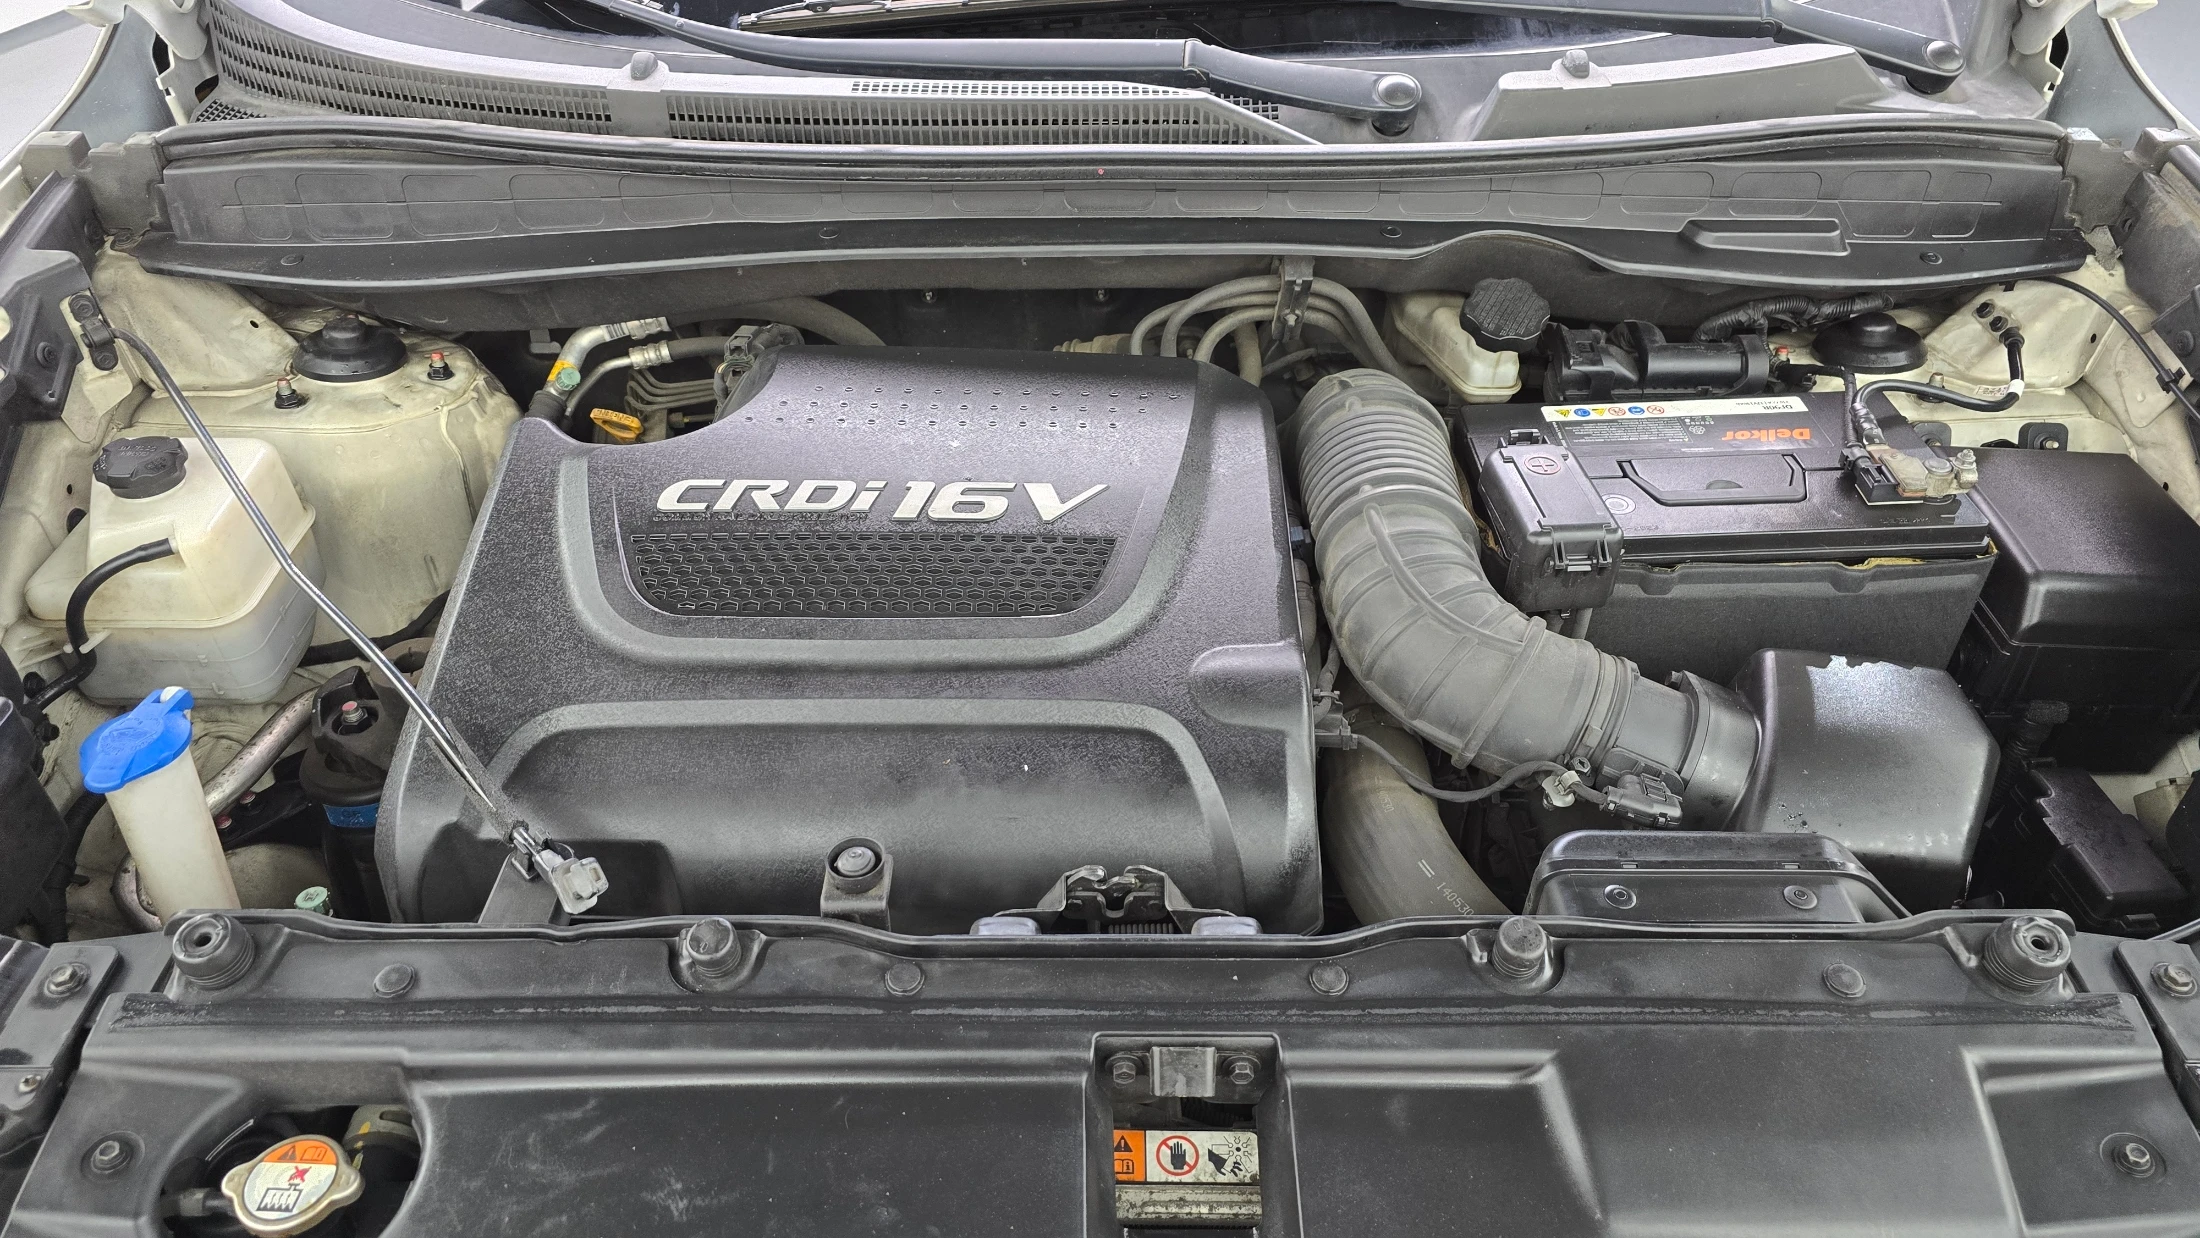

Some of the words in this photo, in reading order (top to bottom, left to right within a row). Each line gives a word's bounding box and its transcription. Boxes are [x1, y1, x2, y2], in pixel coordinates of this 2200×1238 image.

[1721, 428, 1811, 442] Delkor
[656, 479, 888, 513] CRDi
[892, 481, 1111, 523] 16V
[1436, 881, 1475, 916] 140530
